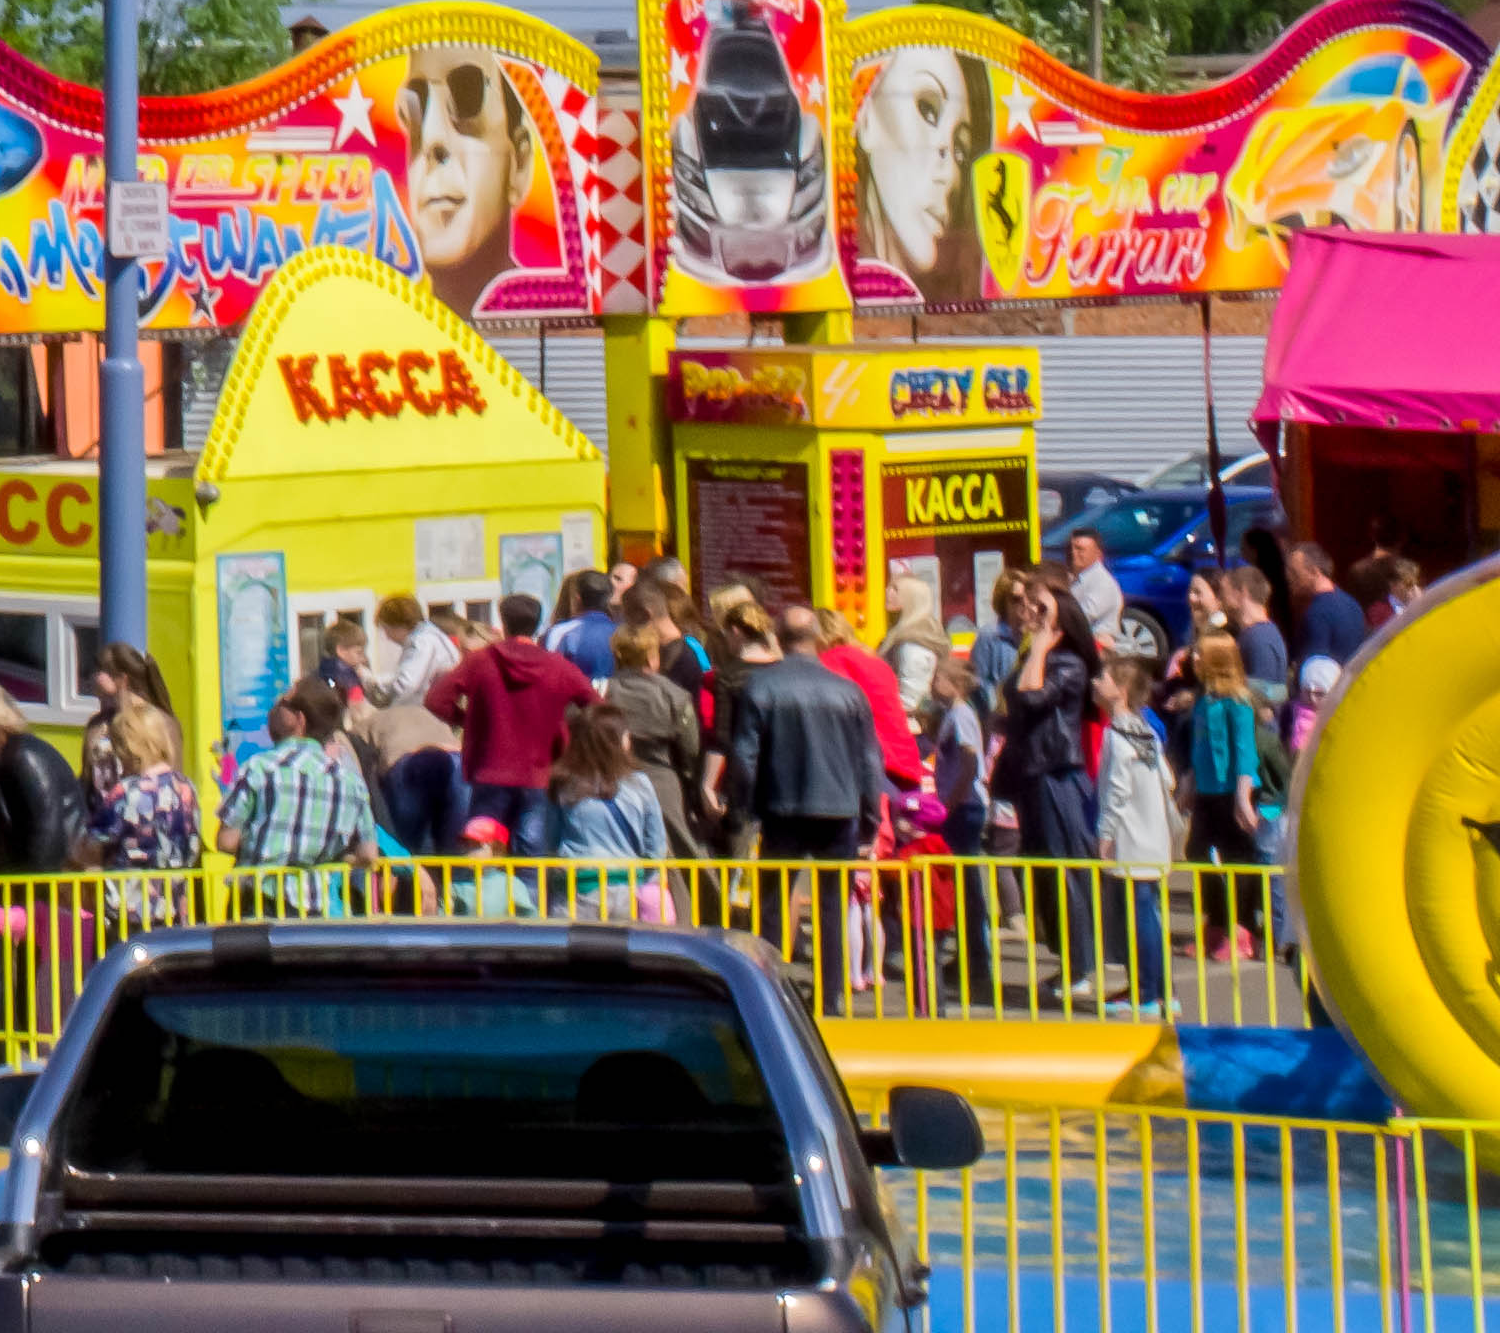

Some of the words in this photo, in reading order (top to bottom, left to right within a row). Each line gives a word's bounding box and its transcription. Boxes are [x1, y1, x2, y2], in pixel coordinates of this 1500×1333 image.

[243, 153, 373, 202] SPEED
[1024, 181, 1211, 288] Ferrari
[276, 347, 489, 426] КАССА
[906, 473, 1005, 525] КАССА
